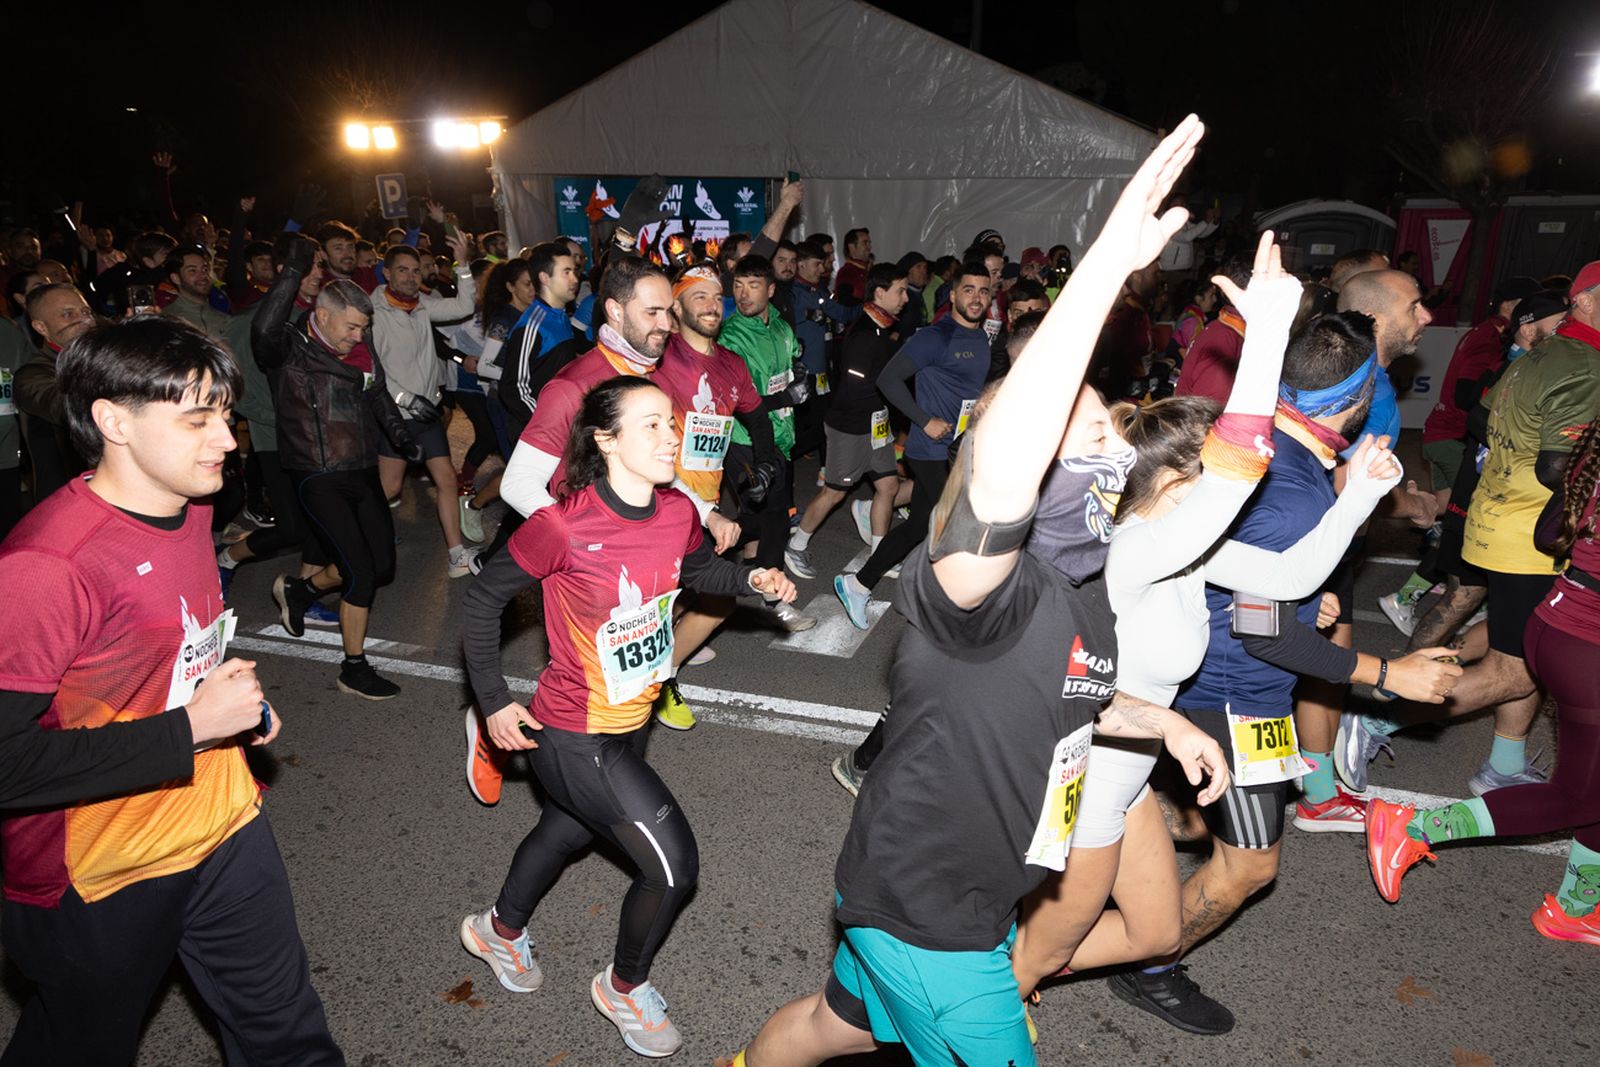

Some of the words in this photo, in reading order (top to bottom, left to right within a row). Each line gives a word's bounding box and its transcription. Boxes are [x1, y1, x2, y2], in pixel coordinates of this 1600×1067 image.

[384, 179, 402, 205] P
[693, 434, 726, 453] 12124
[619, 614, 648, 632] NOCHE
[609, 632, 630, 647] SAN
[184, 662, 202, 681] SAN
[1251, 718, 1290, 751] 7372
